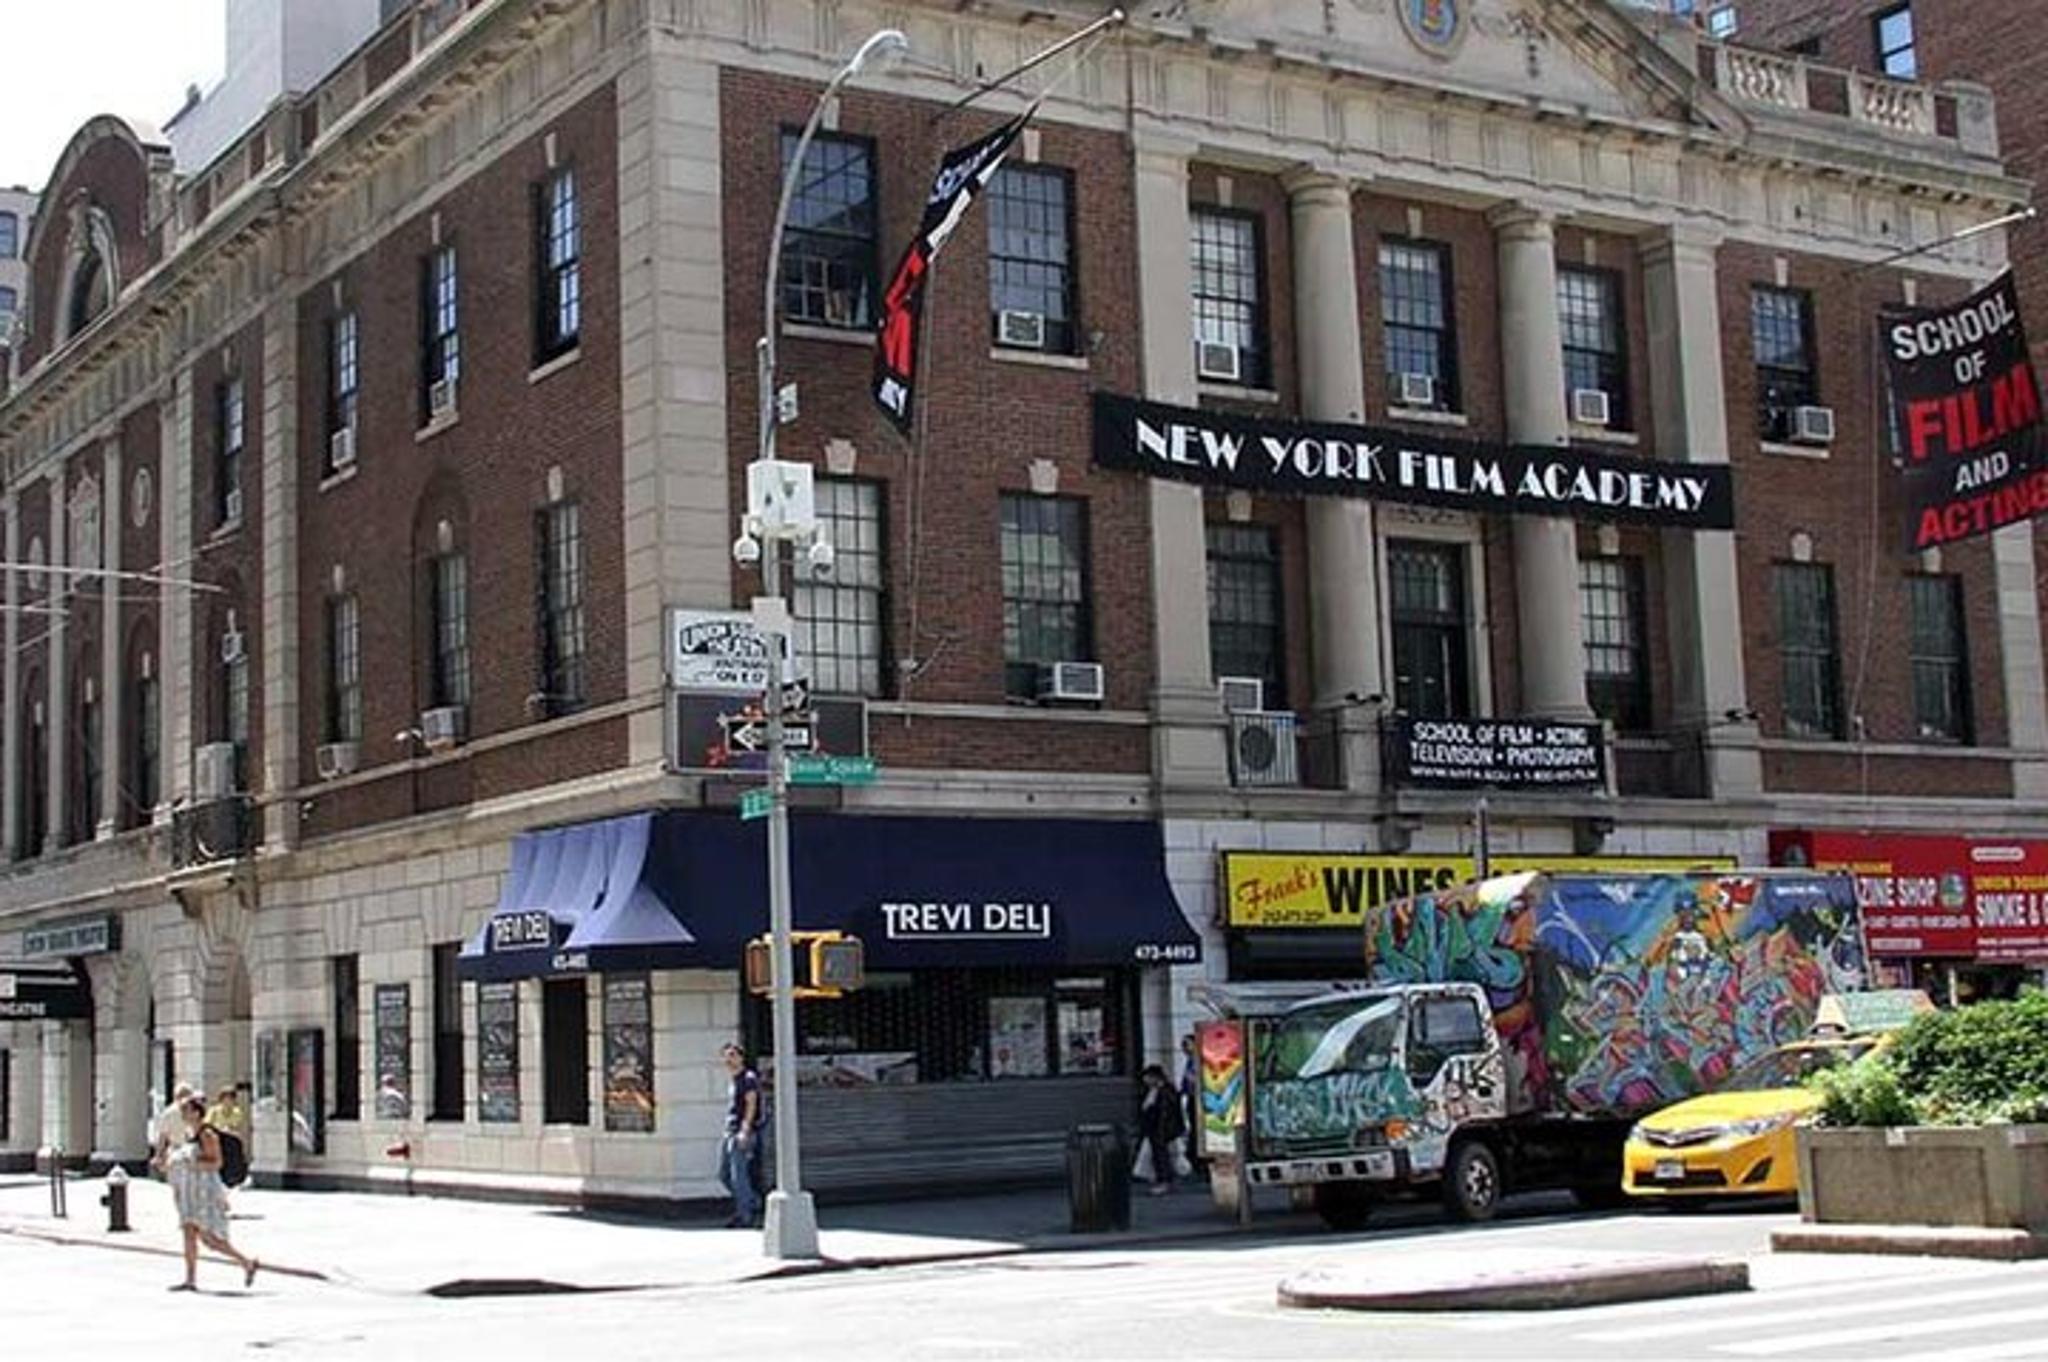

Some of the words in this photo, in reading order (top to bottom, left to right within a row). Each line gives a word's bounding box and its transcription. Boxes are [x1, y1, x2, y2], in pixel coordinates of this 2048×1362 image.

[1892, 293, 2015, 359] SCHOOL
[1955, 351, 1987, 383] OF
[1908, 363, 2039, 458] FILM
[1136, 416, 1244, 472] NEW
[1260, 436, 1386, 482] YORK
[1399, 451, 1506, 496] FILM
[1516, 461, 1710, 511] ACADEMY
[1955, 451, 2010, 491] AND
[1413, 722, 1474, 743] SCHOOL
[1476, 725, 1495, 744] OF
[1500, 725, 1534, 745] FILM
[1411, 742, 1494, 765] TELEVISION
[1236, 866, 1318, 906] Frank's
[1898, 878, 1936, 907] SHOP
[882, 904, 971, 938] TREVI
[983, 904, 1049, 938] DELI
